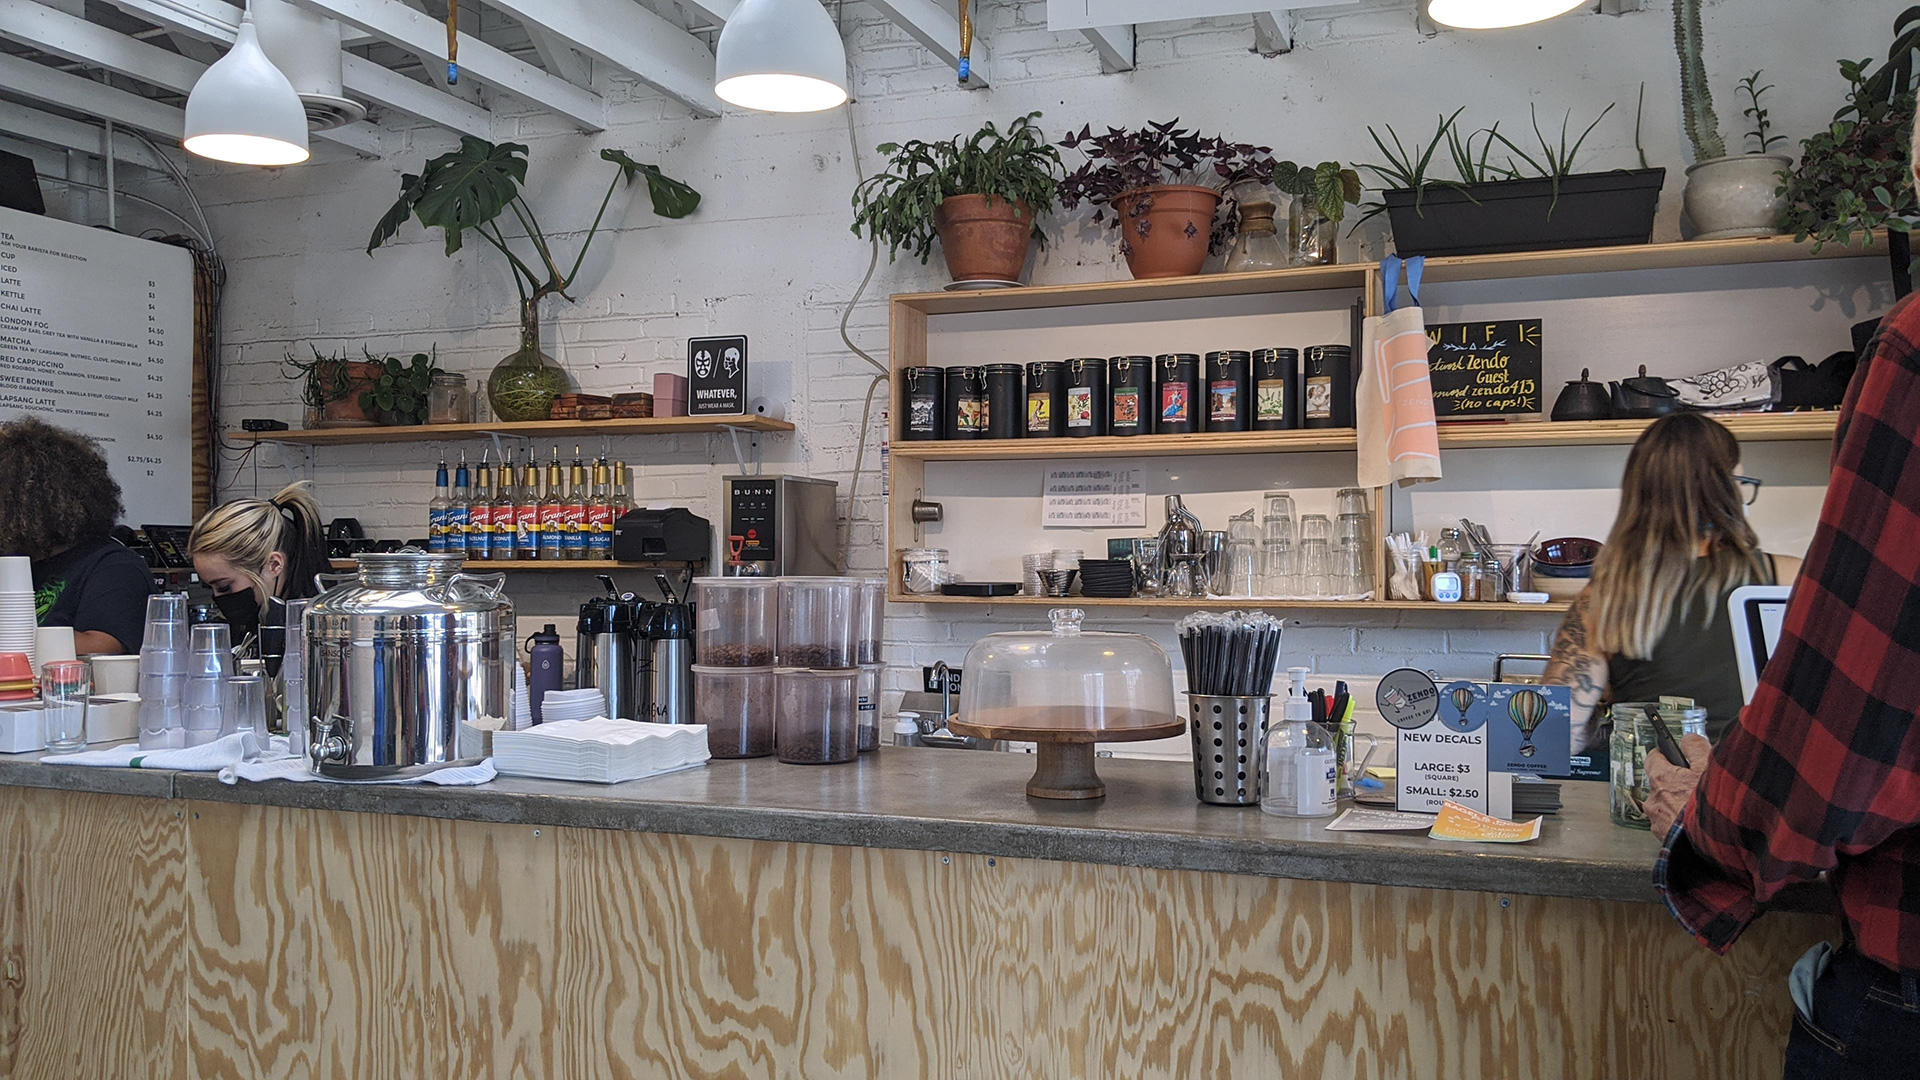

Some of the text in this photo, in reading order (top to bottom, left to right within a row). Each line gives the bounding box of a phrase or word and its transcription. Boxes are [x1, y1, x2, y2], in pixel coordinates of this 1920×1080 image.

[1, 232, 15, 240] TEA
[1, 252, 16, 260] CUP
[28, 246, 48, 254] BARISTA
[61, 252, 87, 262] SELECTION
[1, 264, 18, 273] ICED
[1, 277, 22, 286] LATTE
[0, 290, 26, 300] KETTLE
[0, 302, 42, 315] CHAI LATTE
[0, 316, 48, 329] LONDON FOG
[148, 327, 164, 335] $4.50
[0, 336, 32, 346] MATCHA
[0, 355, 64, 369] RED CAPPUCCINO
[148, 356, 164, 364] $4.50
[1467, 350, 1510, 370] Zendo
[0, 374, 54, 387] SWEET BONNIE
[1476, 369, 1510, 384] Guest
[1472, 380, 1535, 396] zendo413
[0, 395, 33, 404] LAPSANG
[696, 388, 738, 400] WHATEVER,
[128, 456, 162, 464] $2.75/$4.25
[1407, 687, 1435, 702] ZENDO
[1404, 733, 1482, 744] NEW DECALS
[1414, 762, 1470, 774] LARGE: $3
[1424, 774, 1459, 782] (SQUARE)
[1406, 786, 1479, 798] SMALL: $2.50
